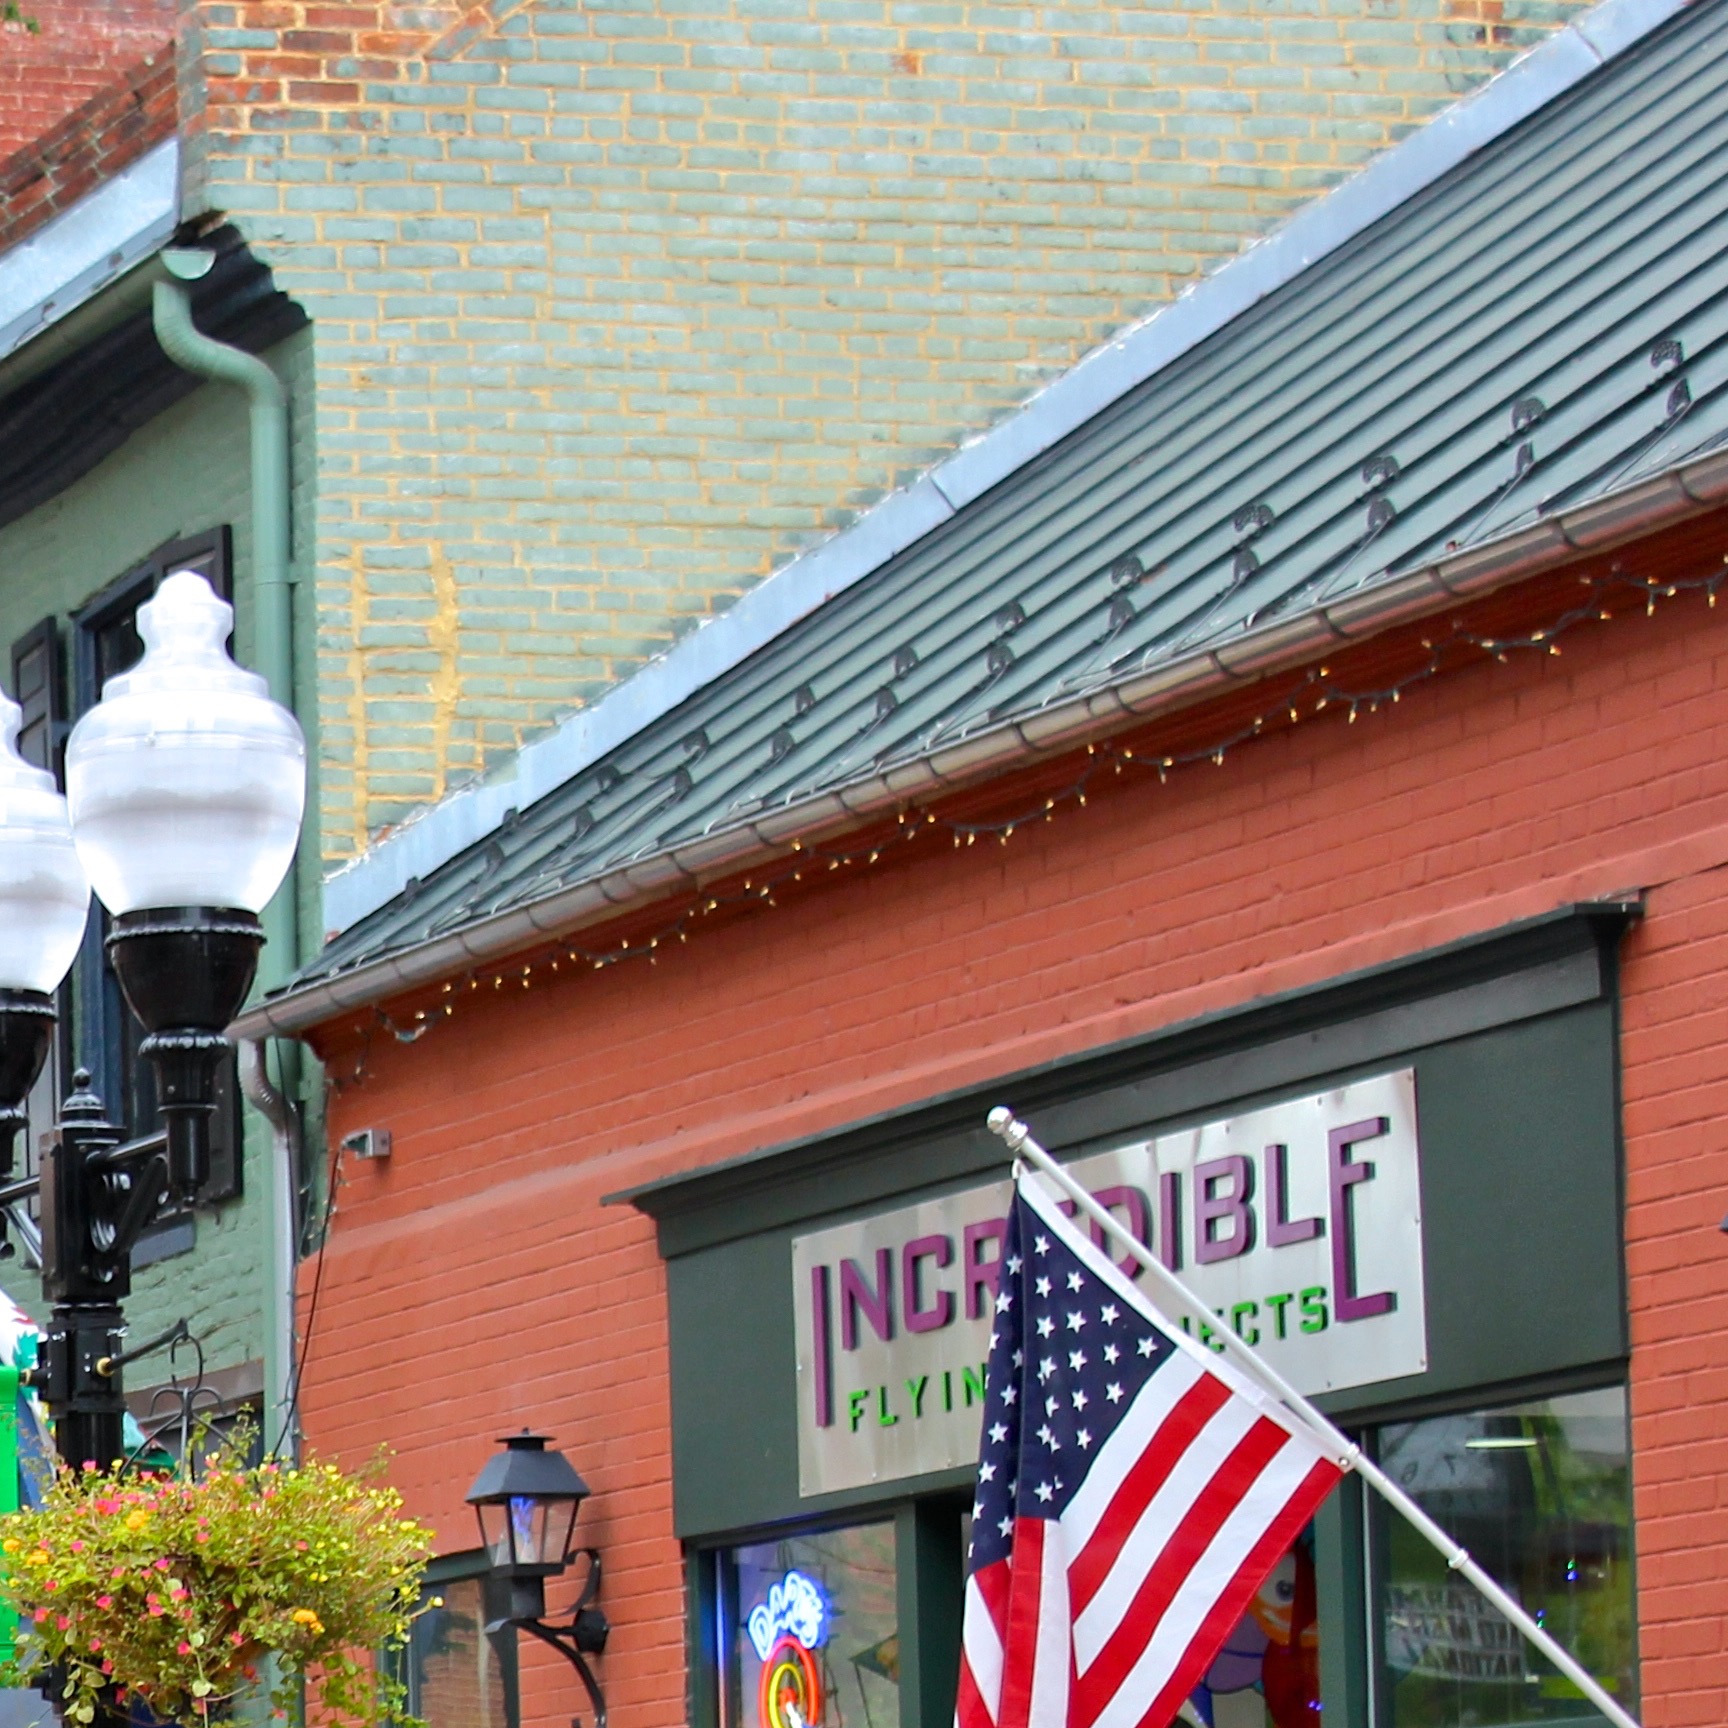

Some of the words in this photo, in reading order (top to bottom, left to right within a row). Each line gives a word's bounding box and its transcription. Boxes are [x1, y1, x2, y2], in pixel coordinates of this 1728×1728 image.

[810, 1115, 1397, 1428] INCRDIBLE
[848, 1362, 988, 1433] FLYIN
[1179, 1286, 1329, 1353] ECTS
